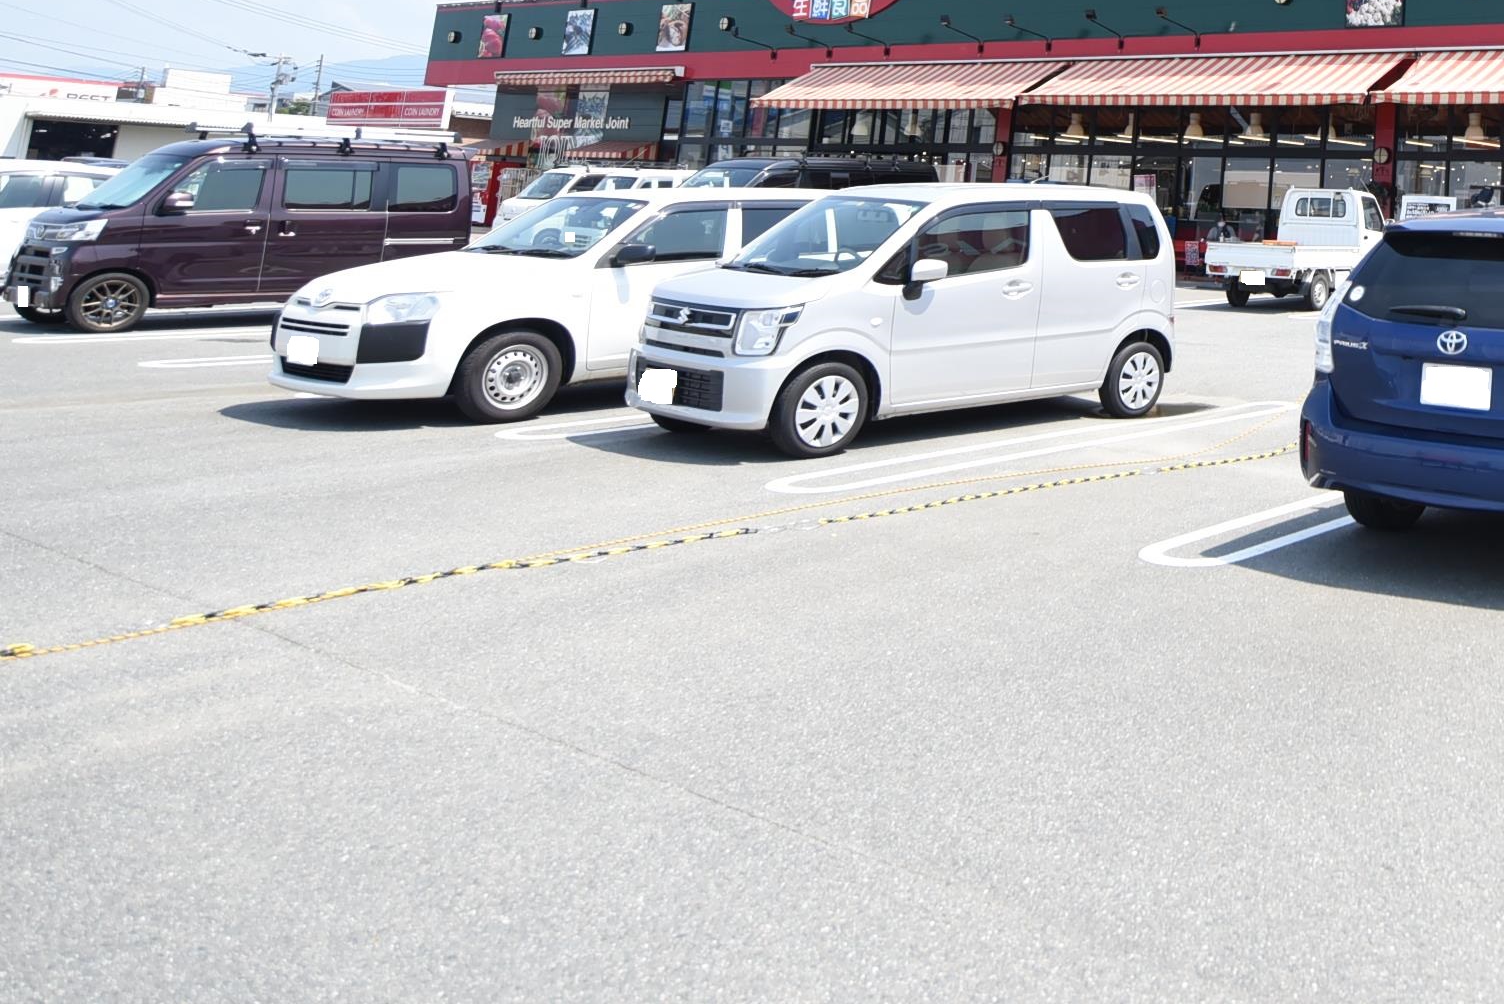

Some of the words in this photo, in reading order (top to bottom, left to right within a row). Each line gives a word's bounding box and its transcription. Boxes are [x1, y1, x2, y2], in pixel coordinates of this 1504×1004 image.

[513, 116, 545, 129] Heartful
[547, 117, 573, 131] Super
[574, 117, 604, 129] Market
[605, 117, 630, 129] Joint
